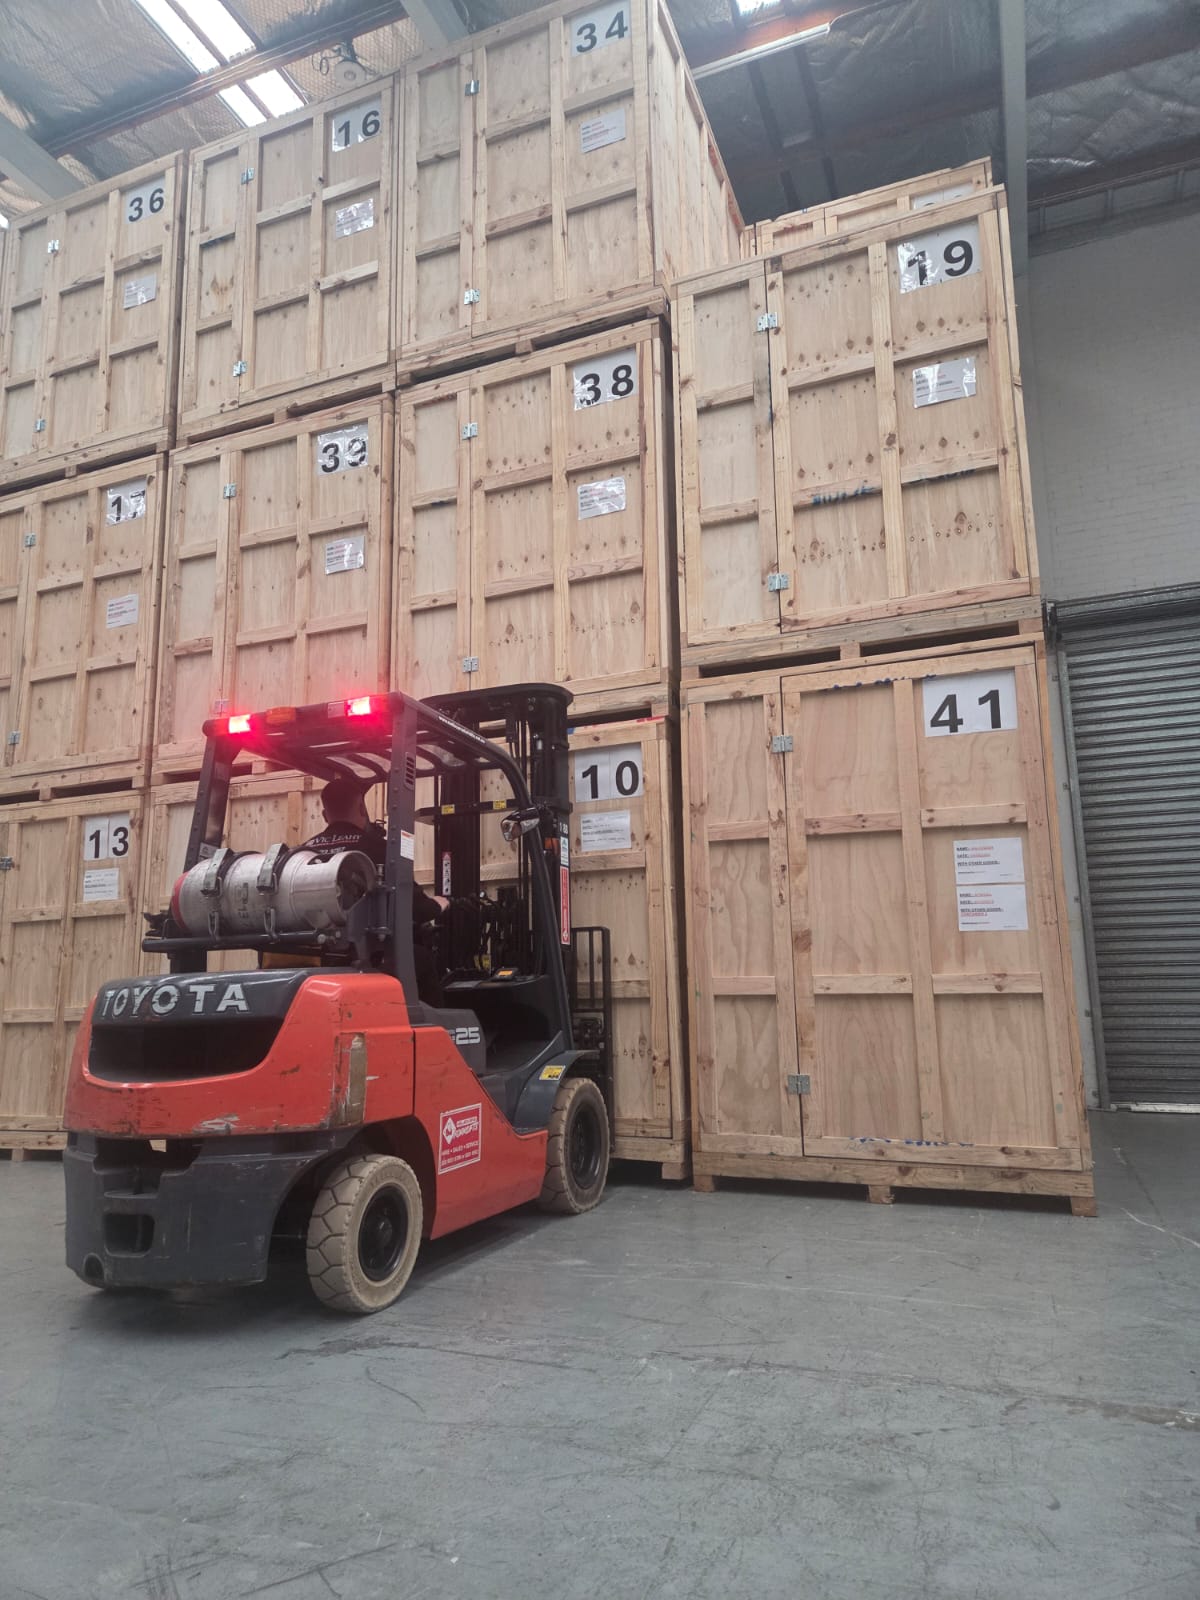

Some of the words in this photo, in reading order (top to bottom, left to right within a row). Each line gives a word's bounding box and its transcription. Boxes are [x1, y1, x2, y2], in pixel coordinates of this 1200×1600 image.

[575, 10, 629, 54] 34
[337, 109, 381, 147] 16
[128, 187, 165, 223] 36
[906, 239, 974, 286] 19
[579, 364, 634, 406] 38
[321, 437, 367, 473] 39
[111, 489, 146, 522] 17
[929, 688, 1002, 733] 41
[581, 760, 640, 800] 10
[89, 826, 129, 859] 13
[102, 983, 249, 1017] TOYOTA
